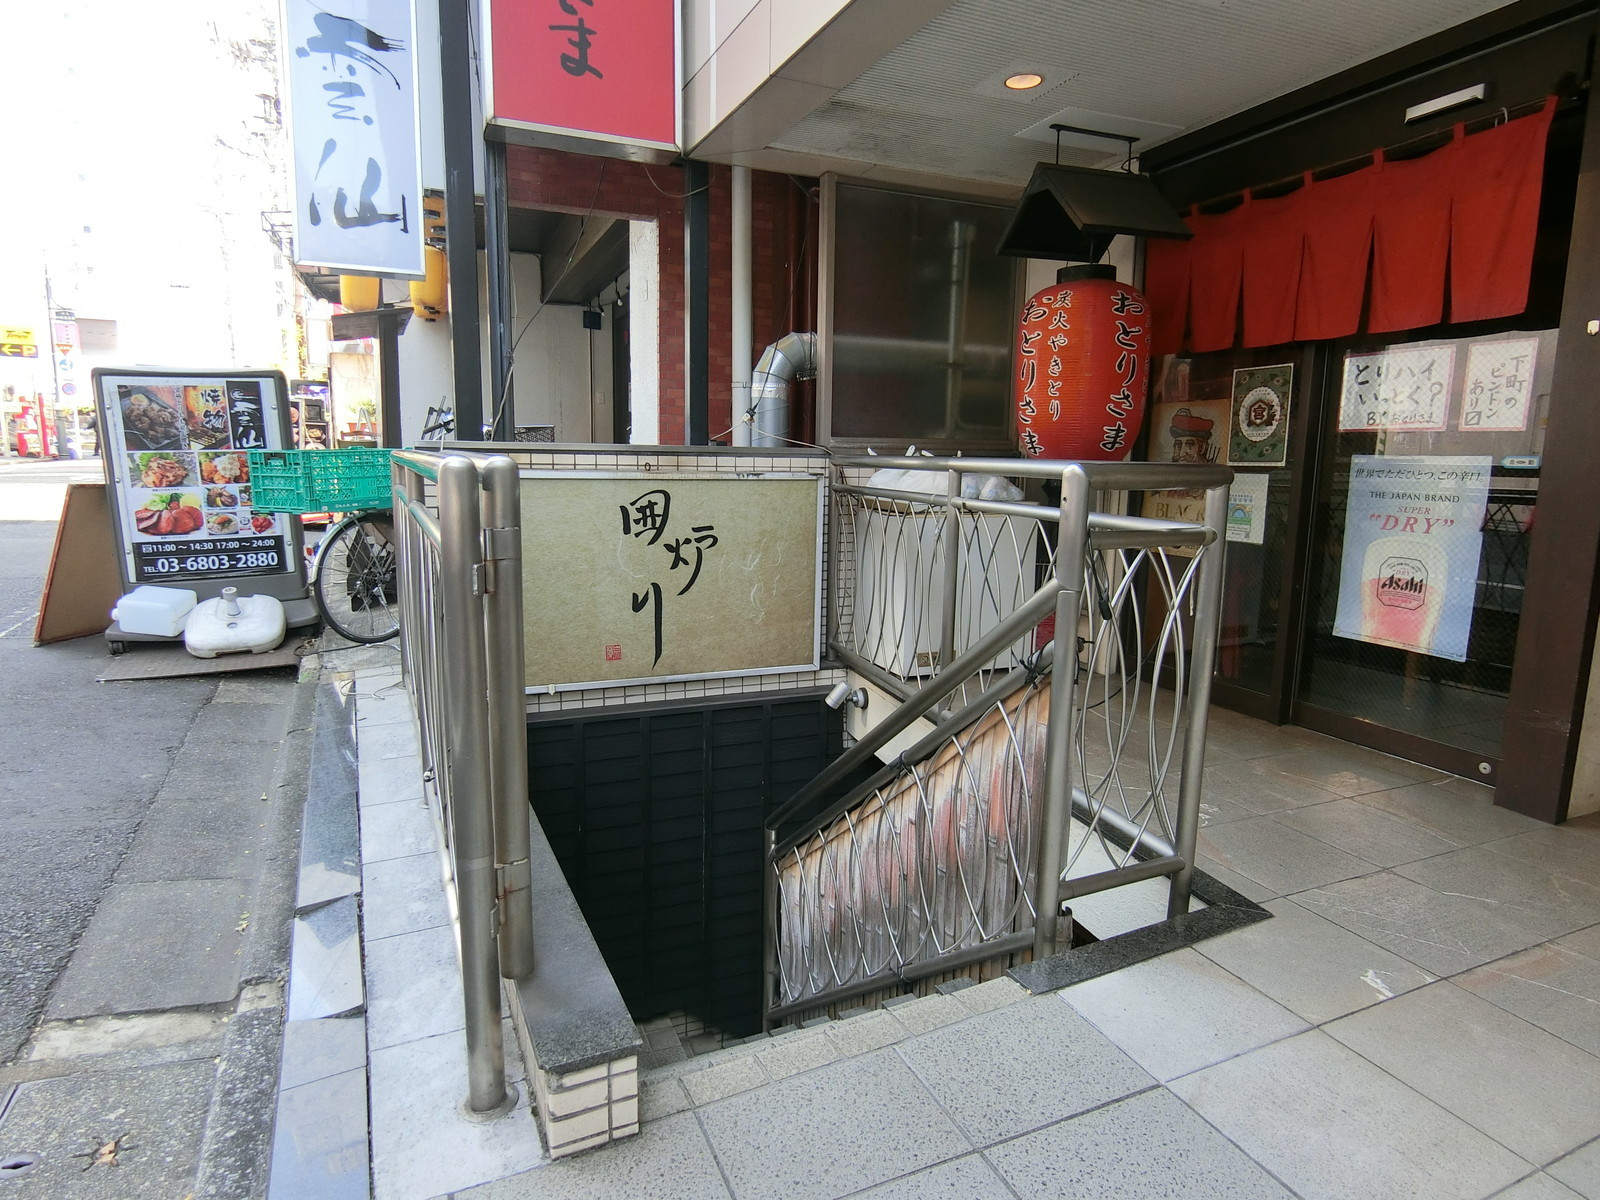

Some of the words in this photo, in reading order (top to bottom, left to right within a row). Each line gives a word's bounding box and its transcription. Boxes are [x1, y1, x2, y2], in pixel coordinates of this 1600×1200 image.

[1018, 296, 1053, 456] おとりさま
[1048, 290, 1073, 421] 炭火やきとり
[1100, 290, 1144, 452] おとりさま
[1486, 362, 1506, 420] ピンドン
[1504, 354, 1529, 410] 下町の
[201, 388, 226, 429] 焼物
[1369, 491, 1387, 500] THE
[1389, 492, 1421, 501] JAPAN
[1424, 493, 1461, 504] BRAND
[1396, 505, 1432, 515] SUPER
[152, 544, 177, 552] 11:00
[189, 542, 214, 551] 14:30
[216, 541, 240, 549] 17:00
[252, 539, 276, 548] 24:00
[1380, 574, 1425, 595] Asahi
